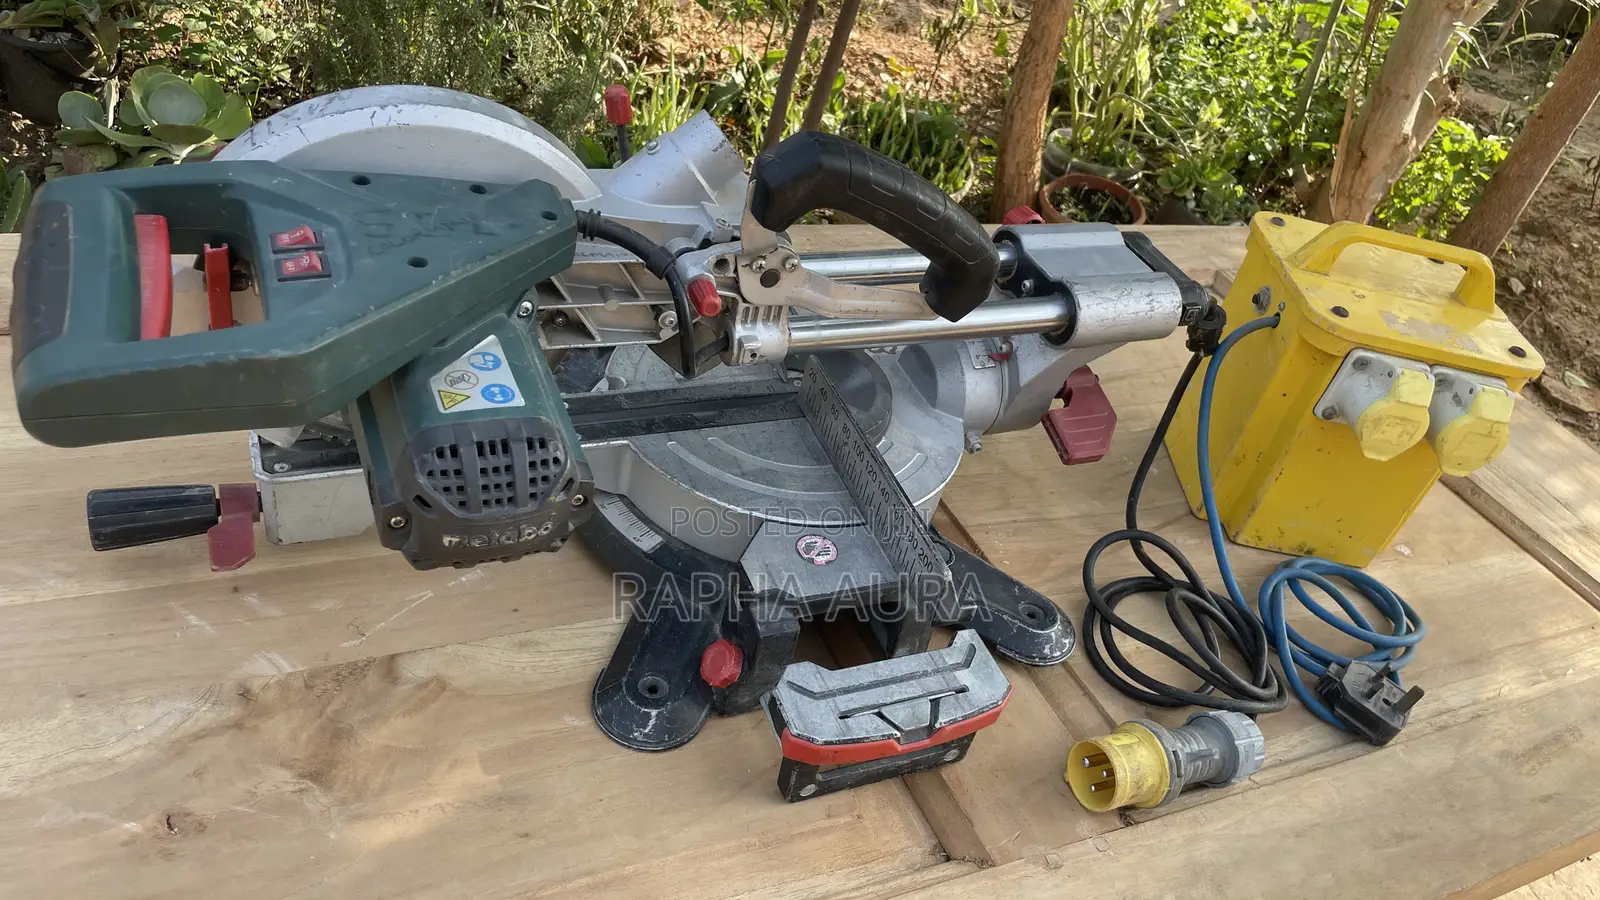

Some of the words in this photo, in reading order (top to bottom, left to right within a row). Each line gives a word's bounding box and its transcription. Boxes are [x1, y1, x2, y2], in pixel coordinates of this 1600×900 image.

[808, 367, 817, 384] 20
[820, 387, 828, 402] 40
[831, 403, 840, 421] 60
[843, 422, 851, 440] 80
[853, 440, 865, 463] 100
[865, 460, 877, 483] 120
[877, 480, 890, 504] 140
[918, 547, 933, 573] 200
